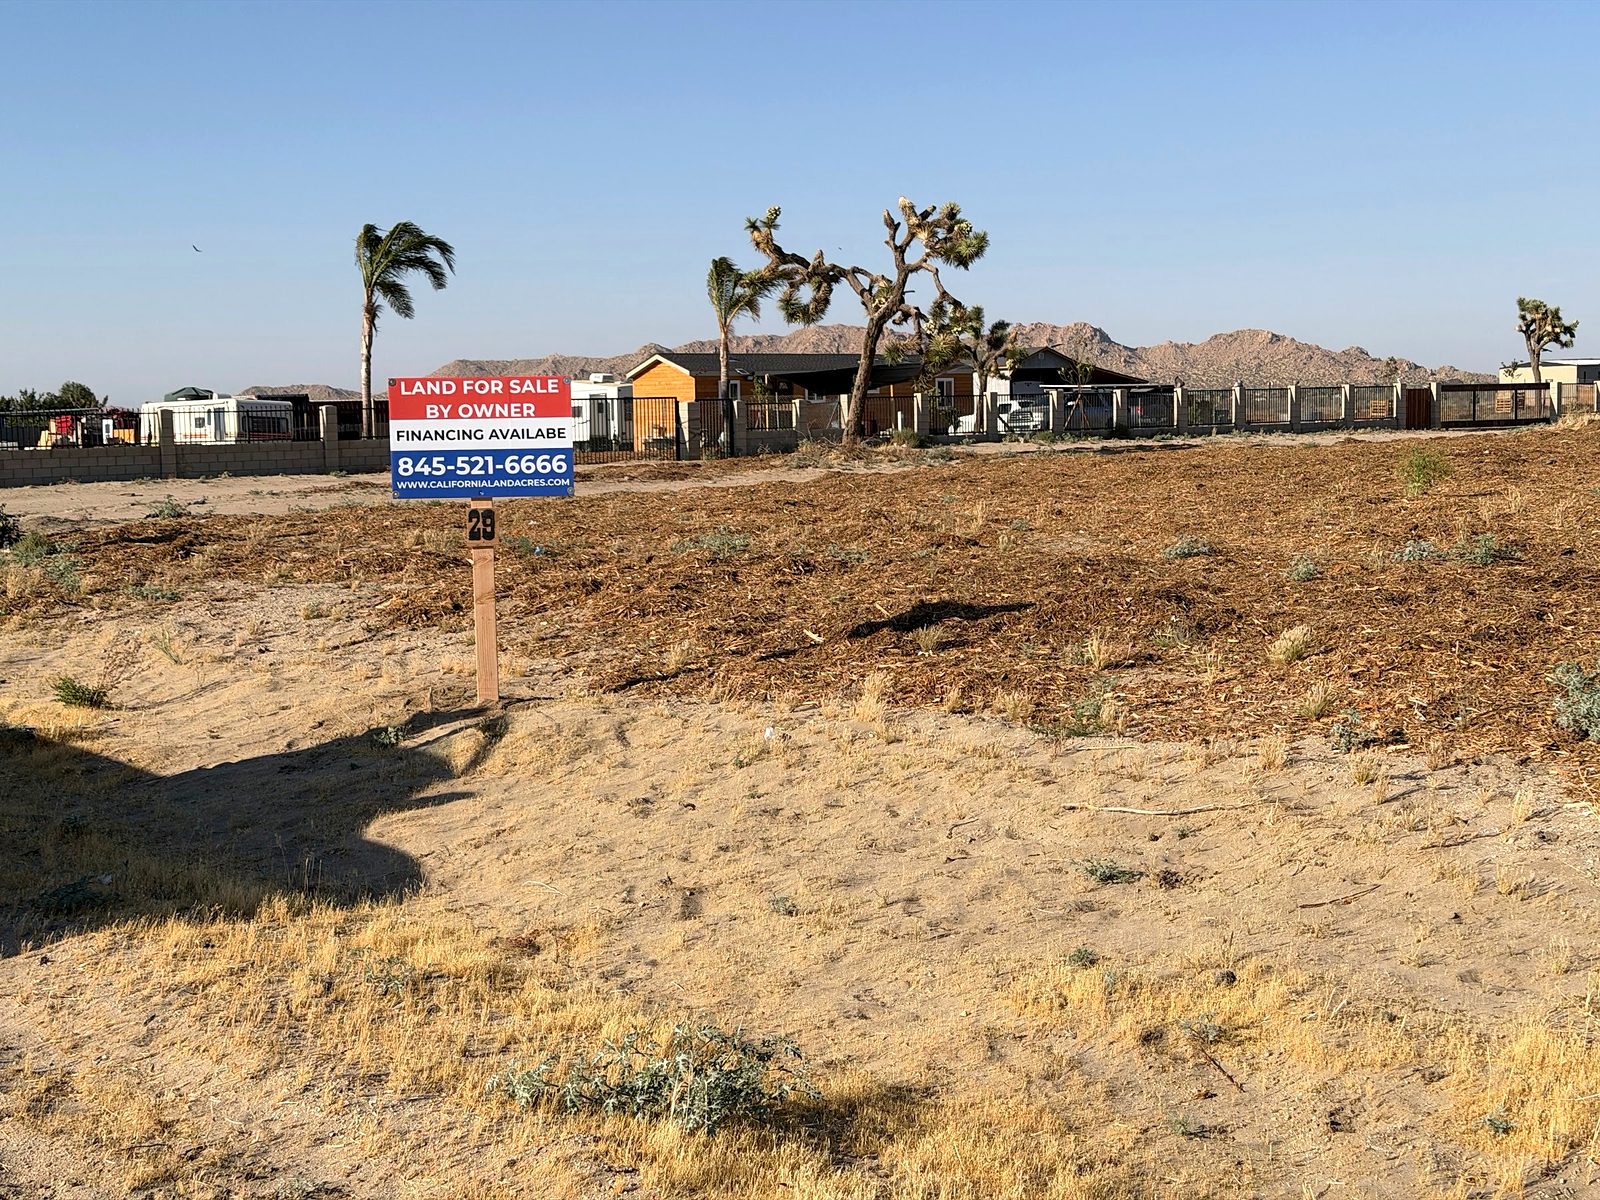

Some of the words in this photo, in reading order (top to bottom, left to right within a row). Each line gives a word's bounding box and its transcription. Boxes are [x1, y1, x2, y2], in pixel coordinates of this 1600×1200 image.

[401, 381, 456, 395] LAND
[463, 380, 503, 394] FOR
[509, 379, 559, 394] SALE
[426, 404, 452, 418] BY
[458, 403, 535, 418] OWNER
[396, 429, 484, 441] FINANCING
[489, 428, 566, 440] AVAILABE
[398, 455, 567, 476] 845-521-6666
[397, 478, 570, 489] WWW.CALIFORNIALANDACRES.COM
[468, 509, 495, 541] 29
